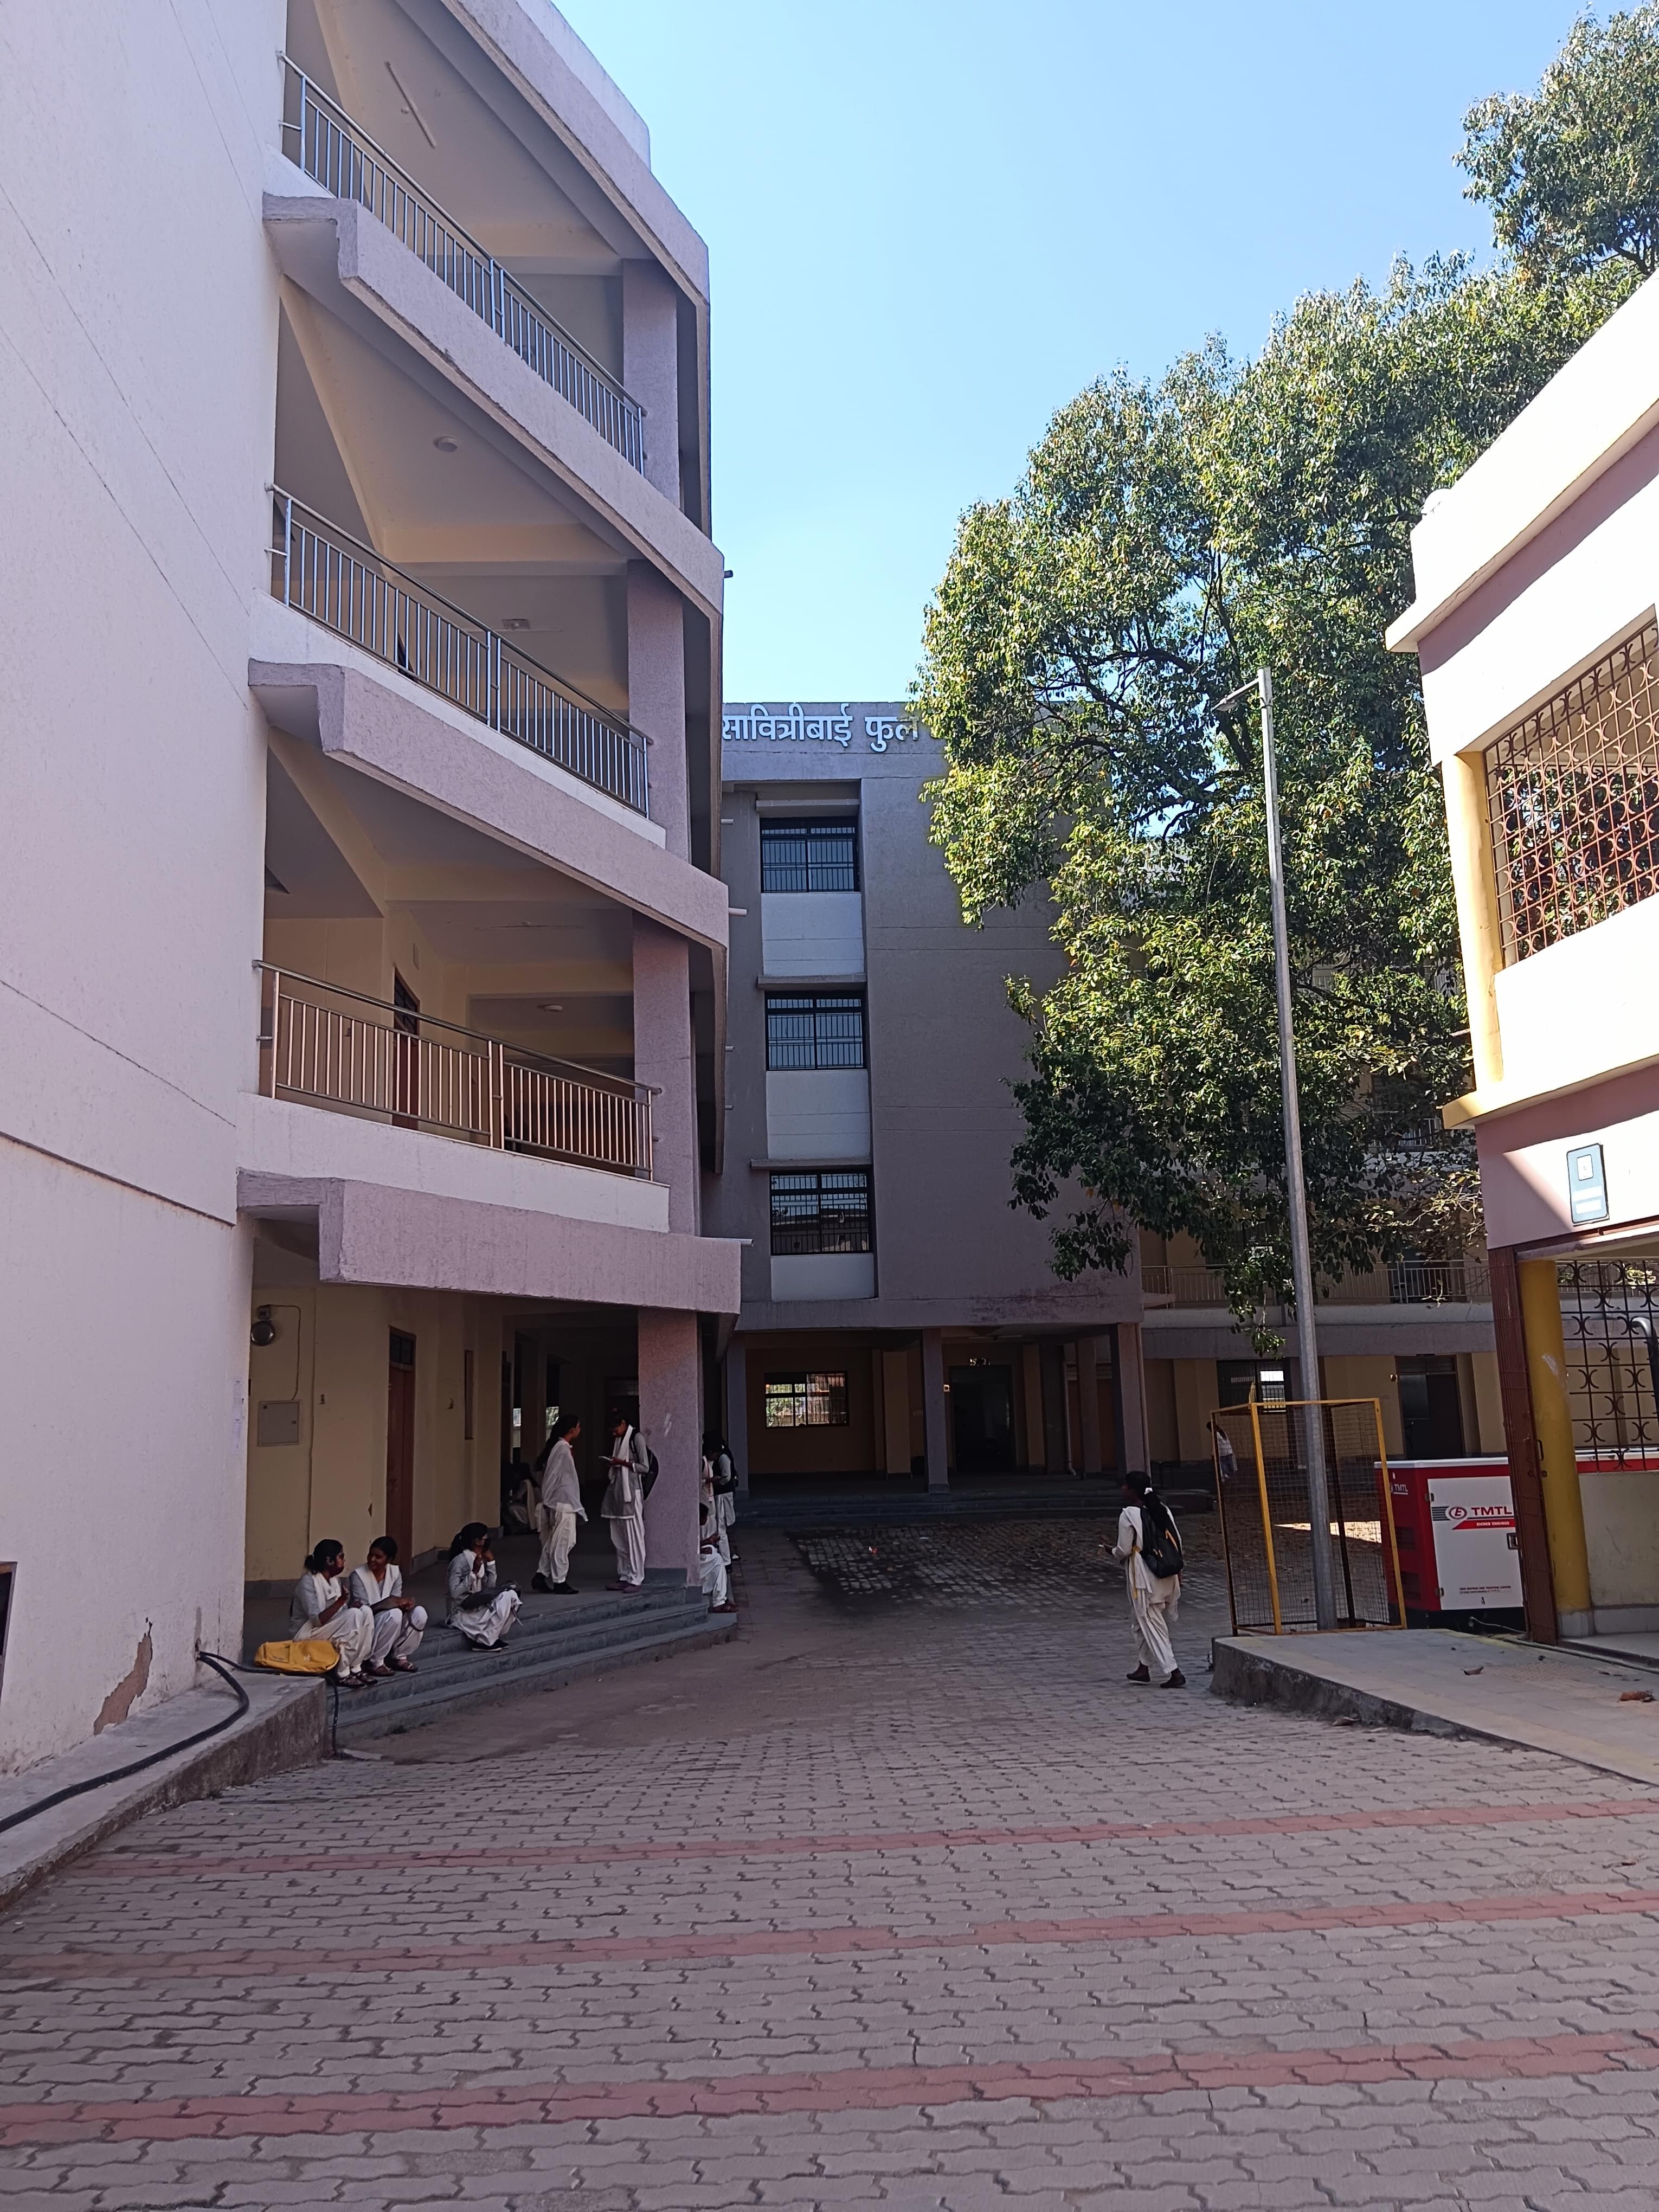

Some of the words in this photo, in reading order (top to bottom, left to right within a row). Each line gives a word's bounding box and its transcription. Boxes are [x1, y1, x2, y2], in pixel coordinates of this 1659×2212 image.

[722, 703, 853, 747] सावित्रीबाई
[1394, 1483, 1409, 1492] TMTL
[1471, 1506, 1513, 1516] TMTL
